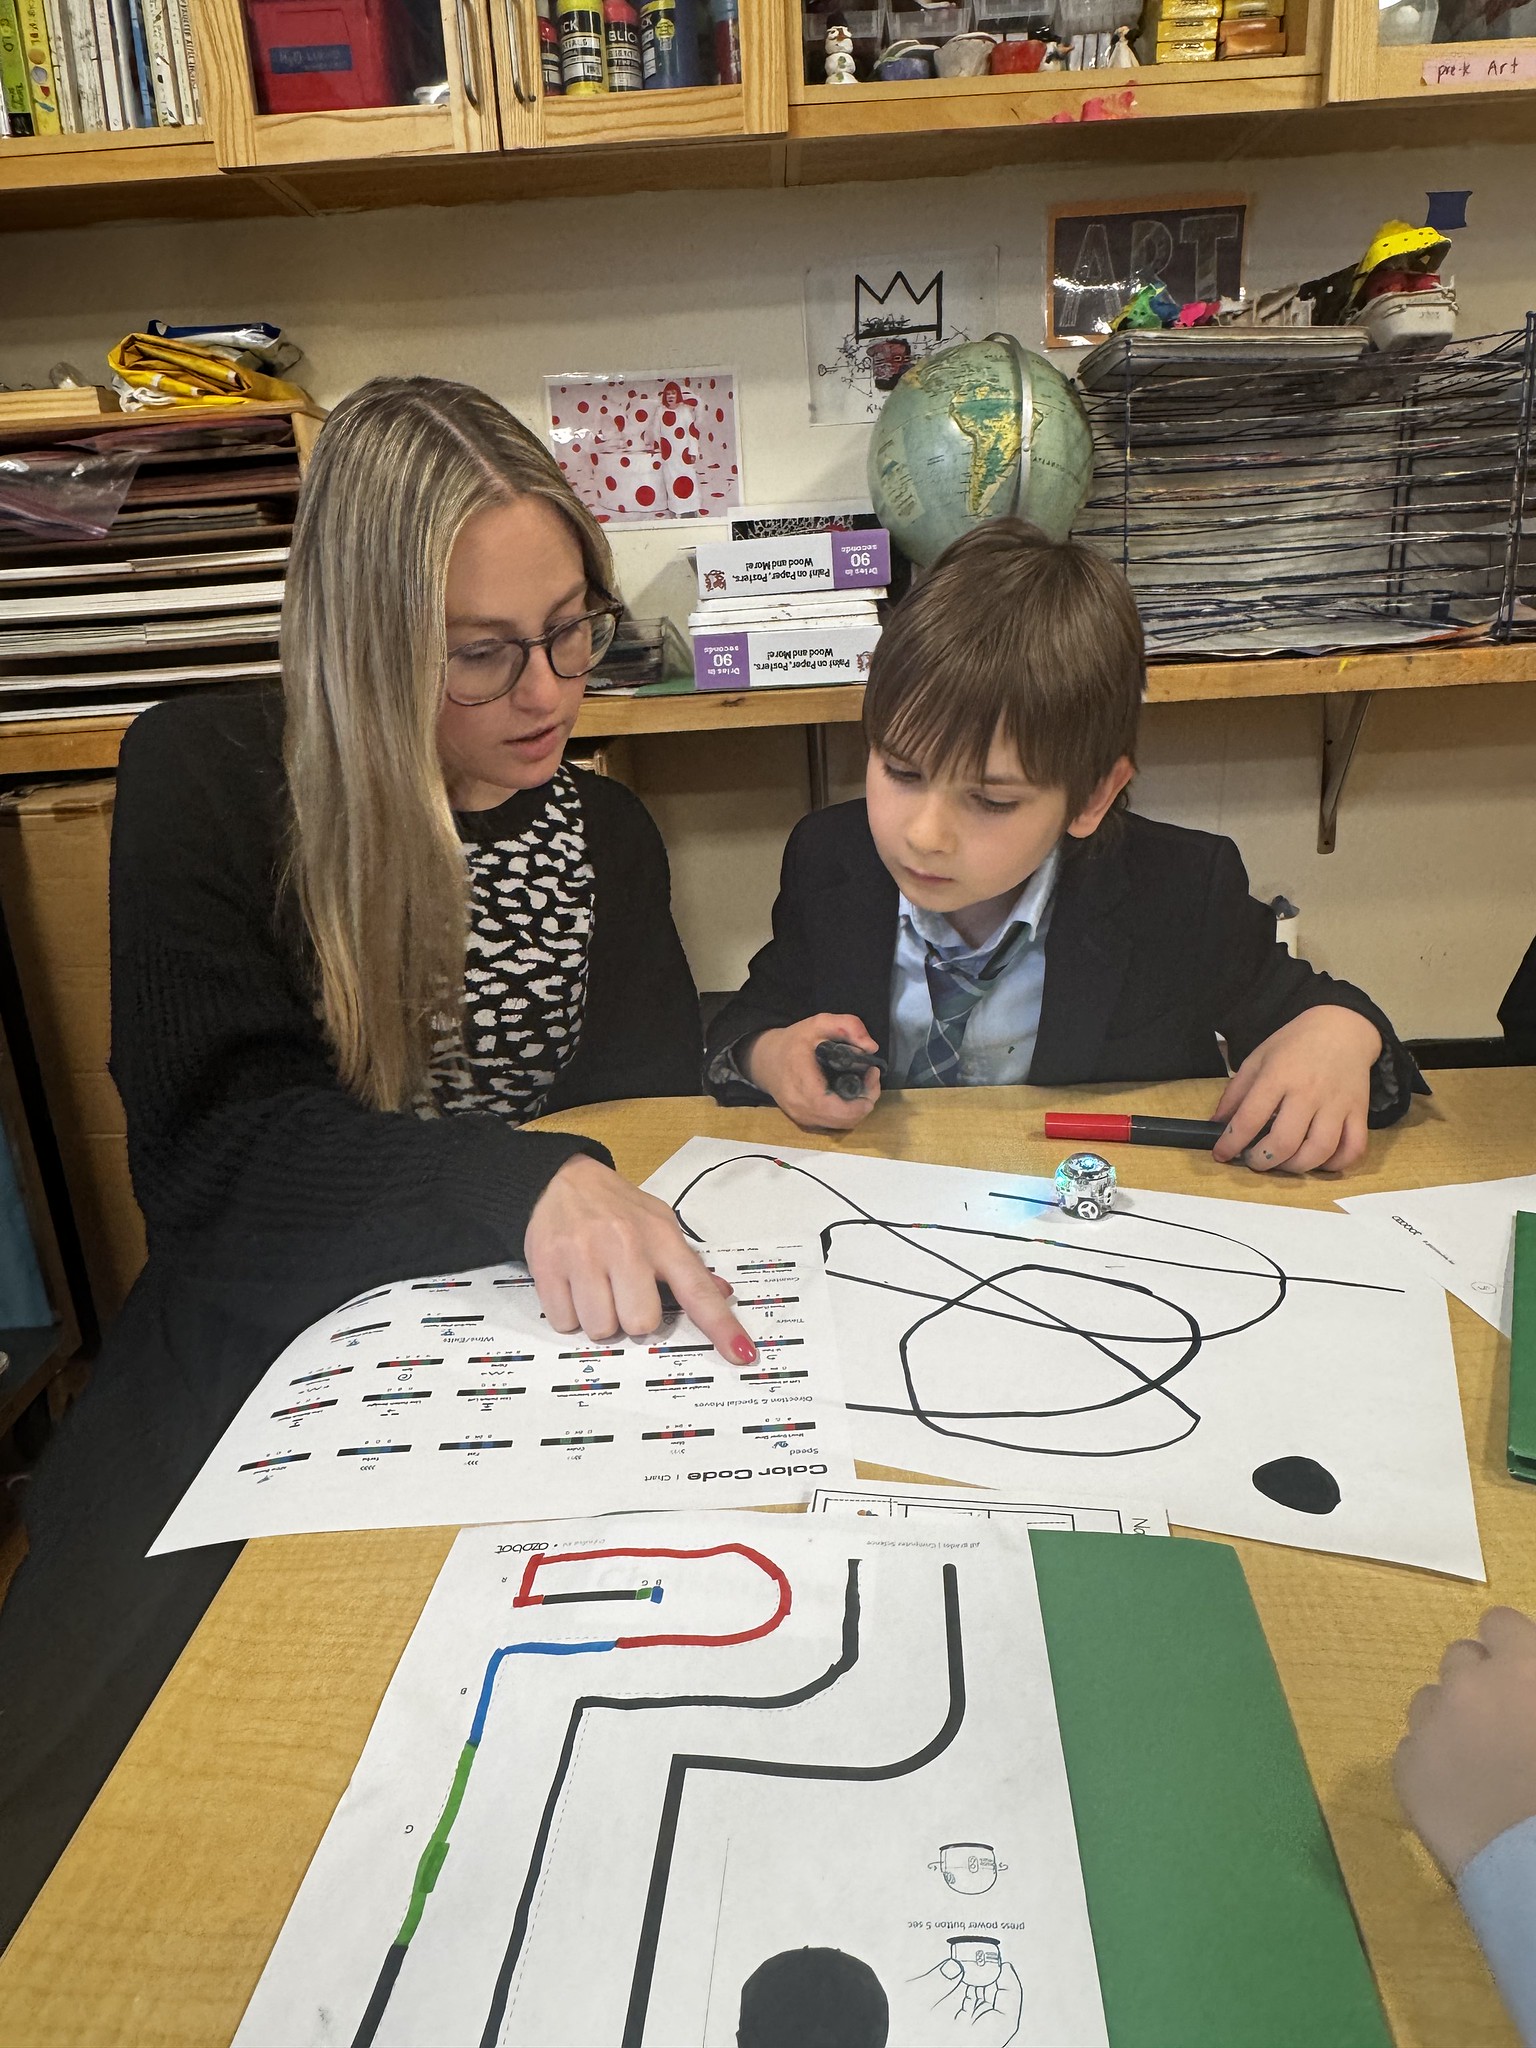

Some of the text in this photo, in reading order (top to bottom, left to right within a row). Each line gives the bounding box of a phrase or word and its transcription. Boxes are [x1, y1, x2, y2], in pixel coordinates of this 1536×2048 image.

[1487, 57, 1519, 76] Art
[1058, 213, 1239, 328] ART
[841, 544, 878, 553] seconds
[745, 557, 814, 571] Wood and More!
[850, 552, 871, 567] 90
[732, 571, 768, 583] Posters,
[770, 570, 795, 581] Paper,
[808, 568, 831, 577] Paint
[845, 567, 878, 576] Dries in
[703, 645, 740, 653] seconds
[767, 648, 834, 660] Wood and More!
[713, 654, 733, 667] 90
[753, 659, 850, 671] Paint on Paper, Posters,
[707, 667, 740, 675] Dries in
[789, 1447, 819, 1455] Speed
[687, 1468, 753, 1482] Code
[758, 1463, 828, 1477] Color
[494, 1542, 549, 1554] ozobot
[908, 1920, 1025, 1930] press power button 5 sec
